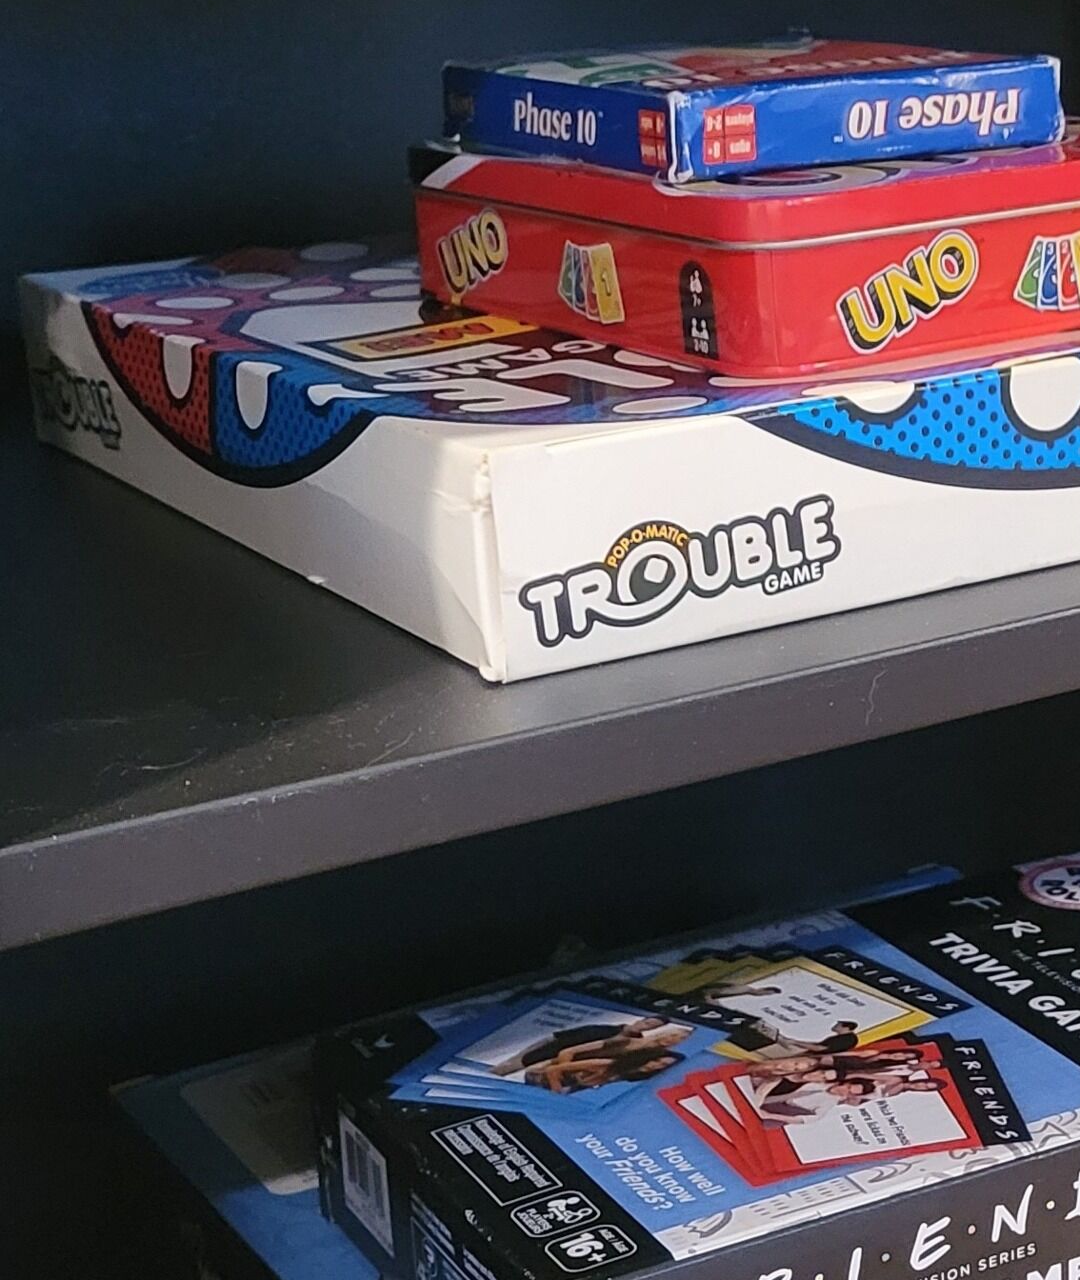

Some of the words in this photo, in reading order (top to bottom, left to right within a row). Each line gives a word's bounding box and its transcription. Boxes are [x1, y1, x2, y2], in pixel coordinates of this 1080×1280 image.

[514, 91, 572, 141] Phase
[576, 108, 598, 147] 10
[847, 99, 890, 141] 10
[899, 88, 1023, 137] Phase
[437, 208, 508, 295] UNO
[837, 230, 979, 353] UNO
[519, 494, 841, 647] TROUBLE
[763, 564, 822, 594] GAME
[929, 932, 1034, 996] TRIVIA
[575, 1133, 614, 1159] your
[604, 1158, 673, 1210] Friends?
[615, 1136, 638, 1153] do
[628, 1152, 663, 1174] you
[654, 1172, 697, 1204] know
[659, 1146, 694, 1172] How
[687, 1172, 726, 1196] well
[559, 1232, 608, 1264] 16+
[977, 1242, 1038, 1273] SERIES
